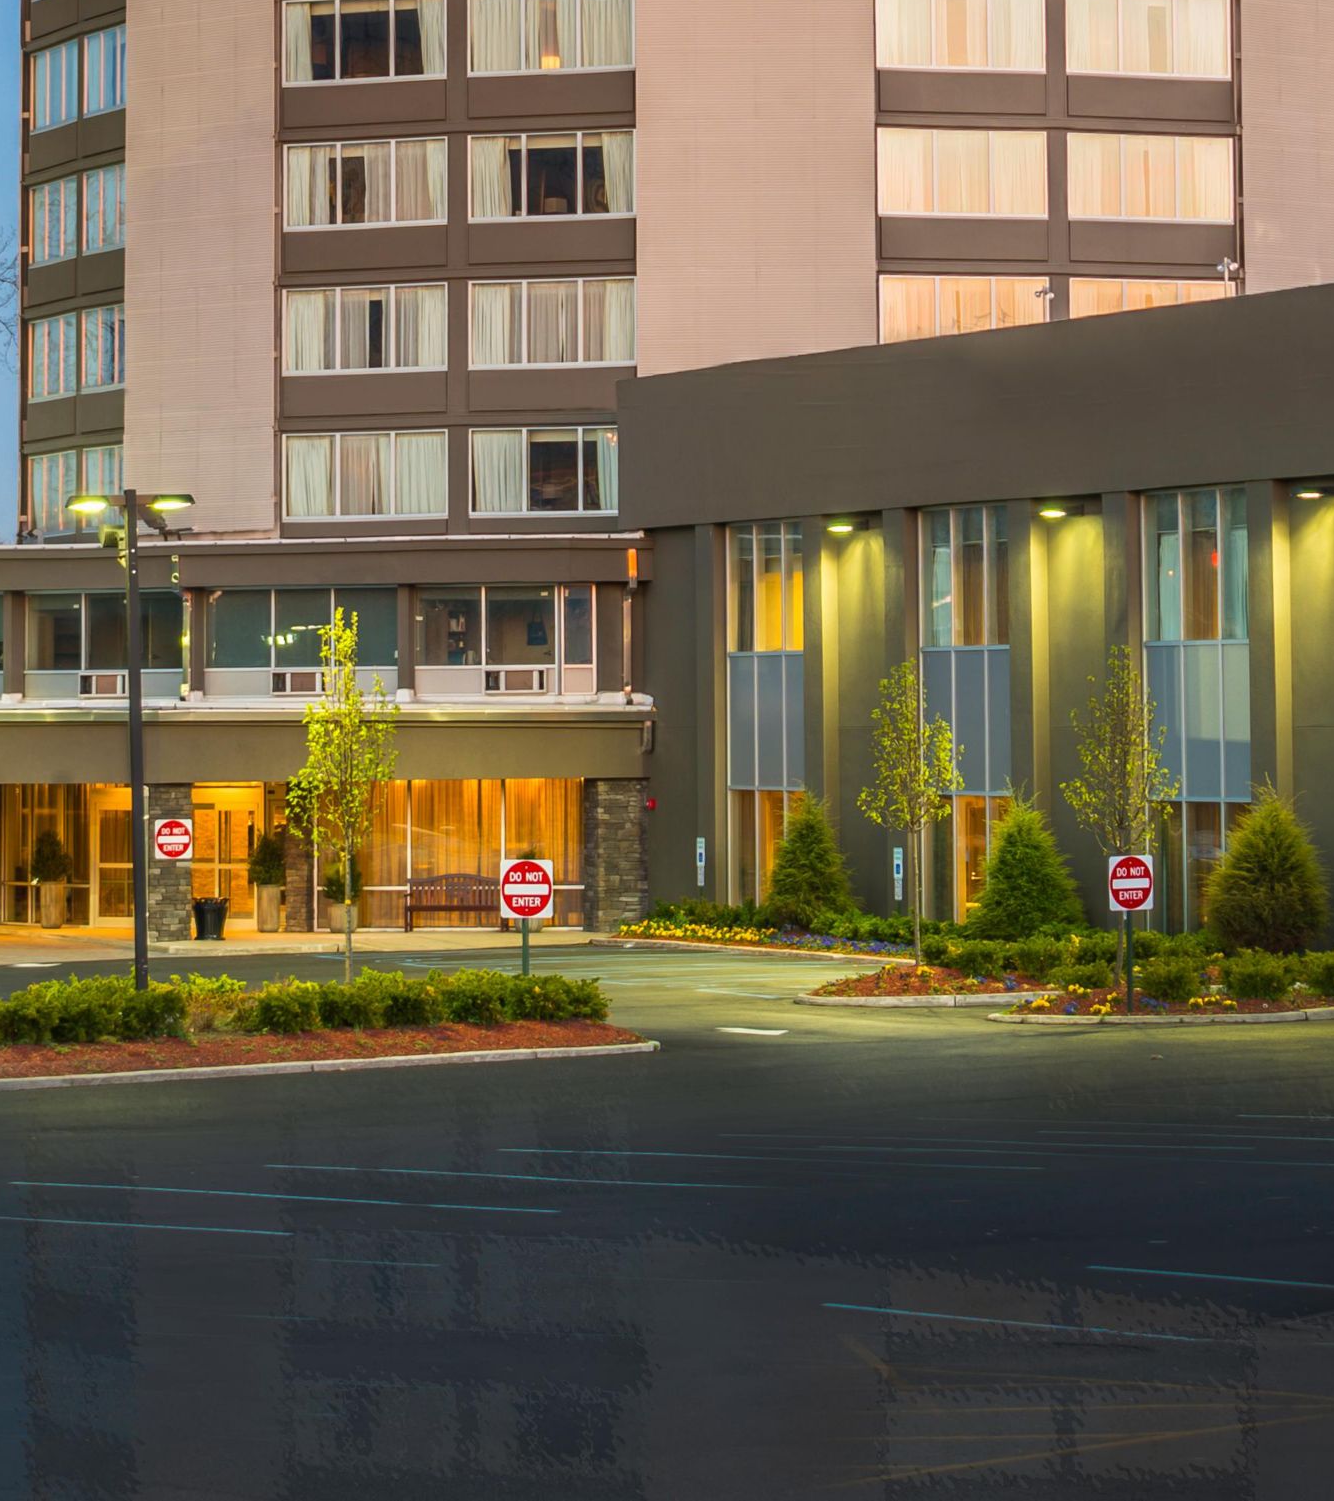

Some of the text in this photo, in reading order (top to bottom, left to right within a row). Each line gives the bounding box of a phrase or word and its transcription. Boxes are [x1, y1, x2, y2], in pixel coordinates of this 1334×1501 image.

[161, 827, 186, 835] DO NOT
[163, 844, 184, 852] ENTER
[509, 871, 544, 882] DO NOT
[1116, 866, 1146, 877] DO NOT
[1119, 890, 1144, 901] ENTER
[512, 896, 541, 908] ENTER
